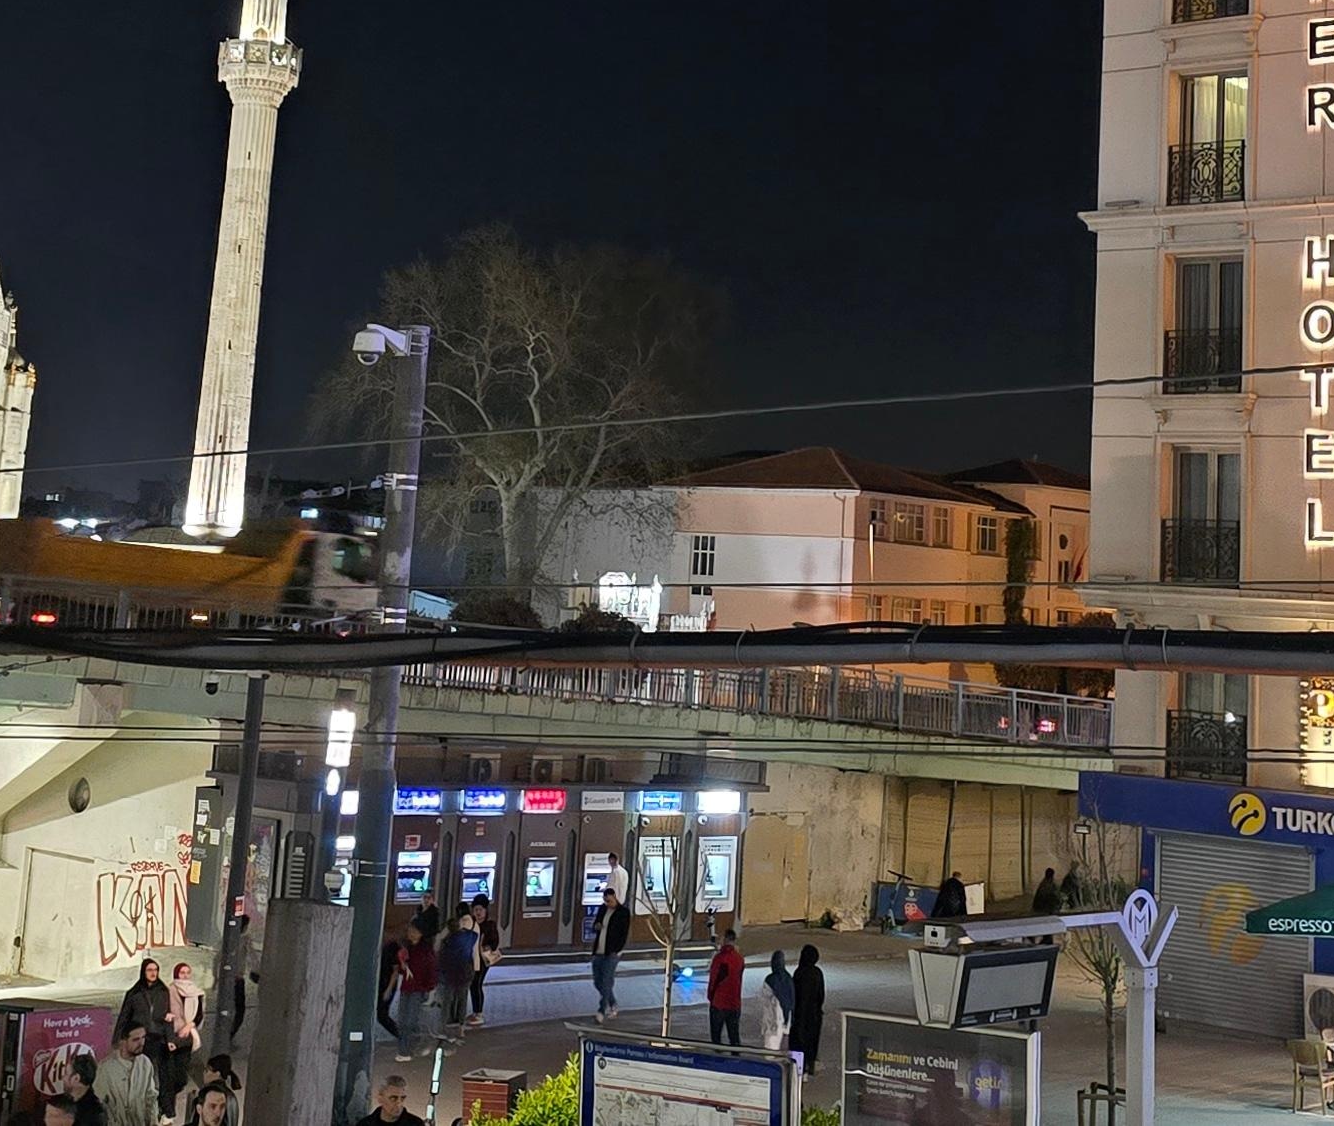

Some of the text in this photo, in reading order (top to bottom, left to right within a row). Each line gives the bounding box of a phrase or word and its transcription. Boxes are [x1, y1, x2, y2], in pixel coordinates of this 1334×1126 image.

[43, 1018, 62, 1028] Have
[55, 1029, 73, 1039] have
[913, 1056, 926, 1066] ve
[974, 1076, 1004, 1091] getir
